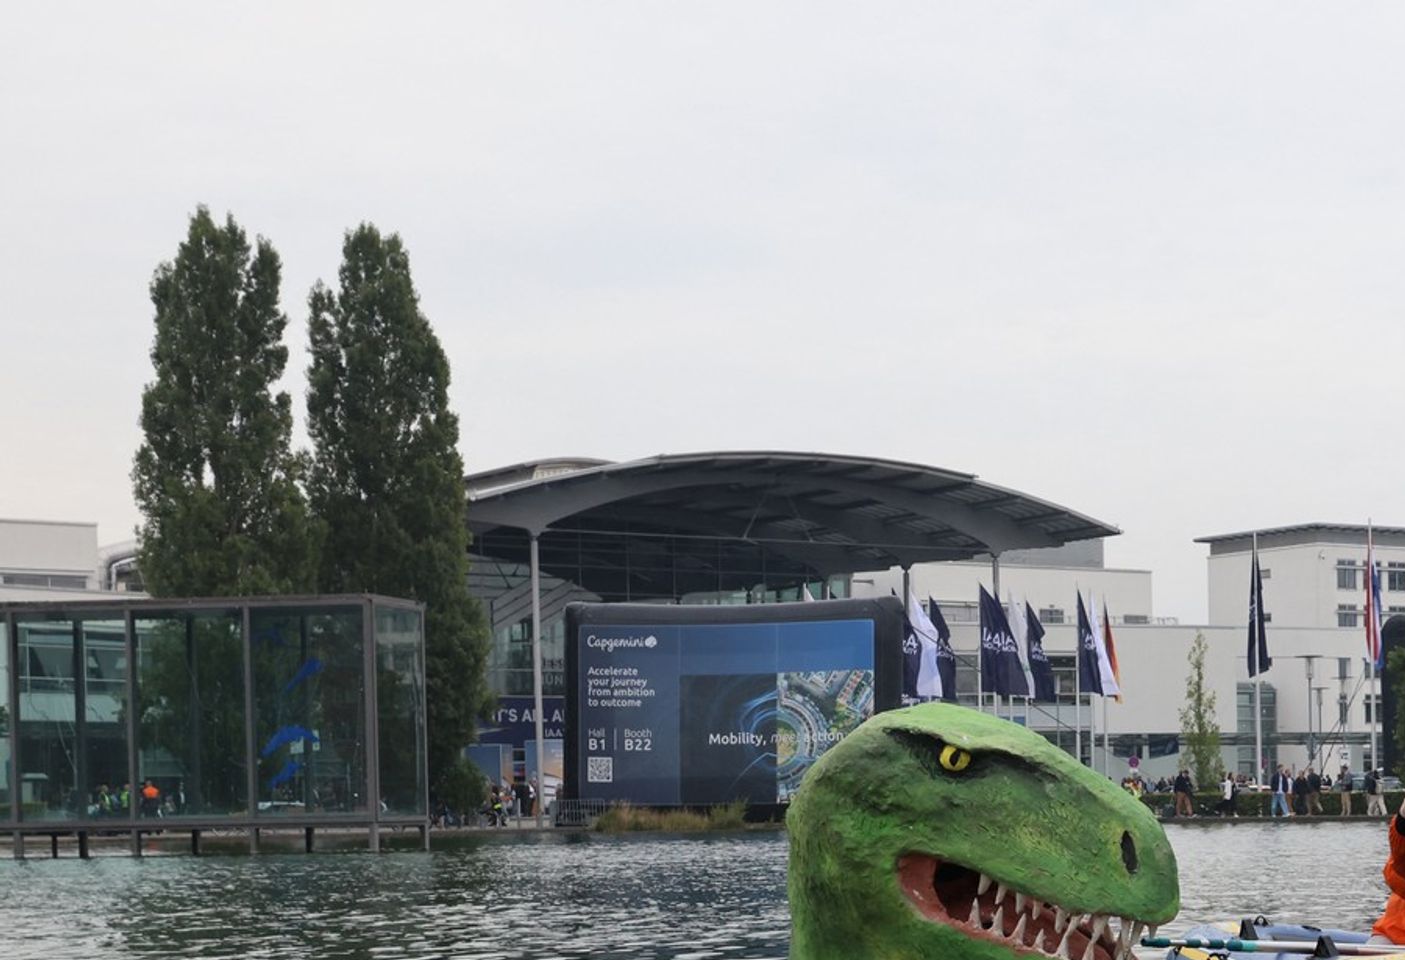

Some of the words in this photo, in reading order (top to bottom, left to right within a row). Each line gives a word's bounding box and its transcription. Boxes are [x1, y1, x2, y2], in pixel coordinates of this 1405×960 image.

[587, 634, 644, 652] Capgemini
[587, 666, 639, 676] Accelerate
[588, 678, 609, 687] your
[610, 677, 648, 688] journey
[588, 687, 611, 696] from
[612, 687, 656, 696] ambition
[588, 698, 599, 707] to
[600, 698, 642, 707] outcome
[588, 728, 606, 738] Hall
[624, 728, 653, 738] Booth
[708, 732, 767, 746] Mobility,
[588, 738, 606, 751] B1
[624, 738, 652, 751] B22
